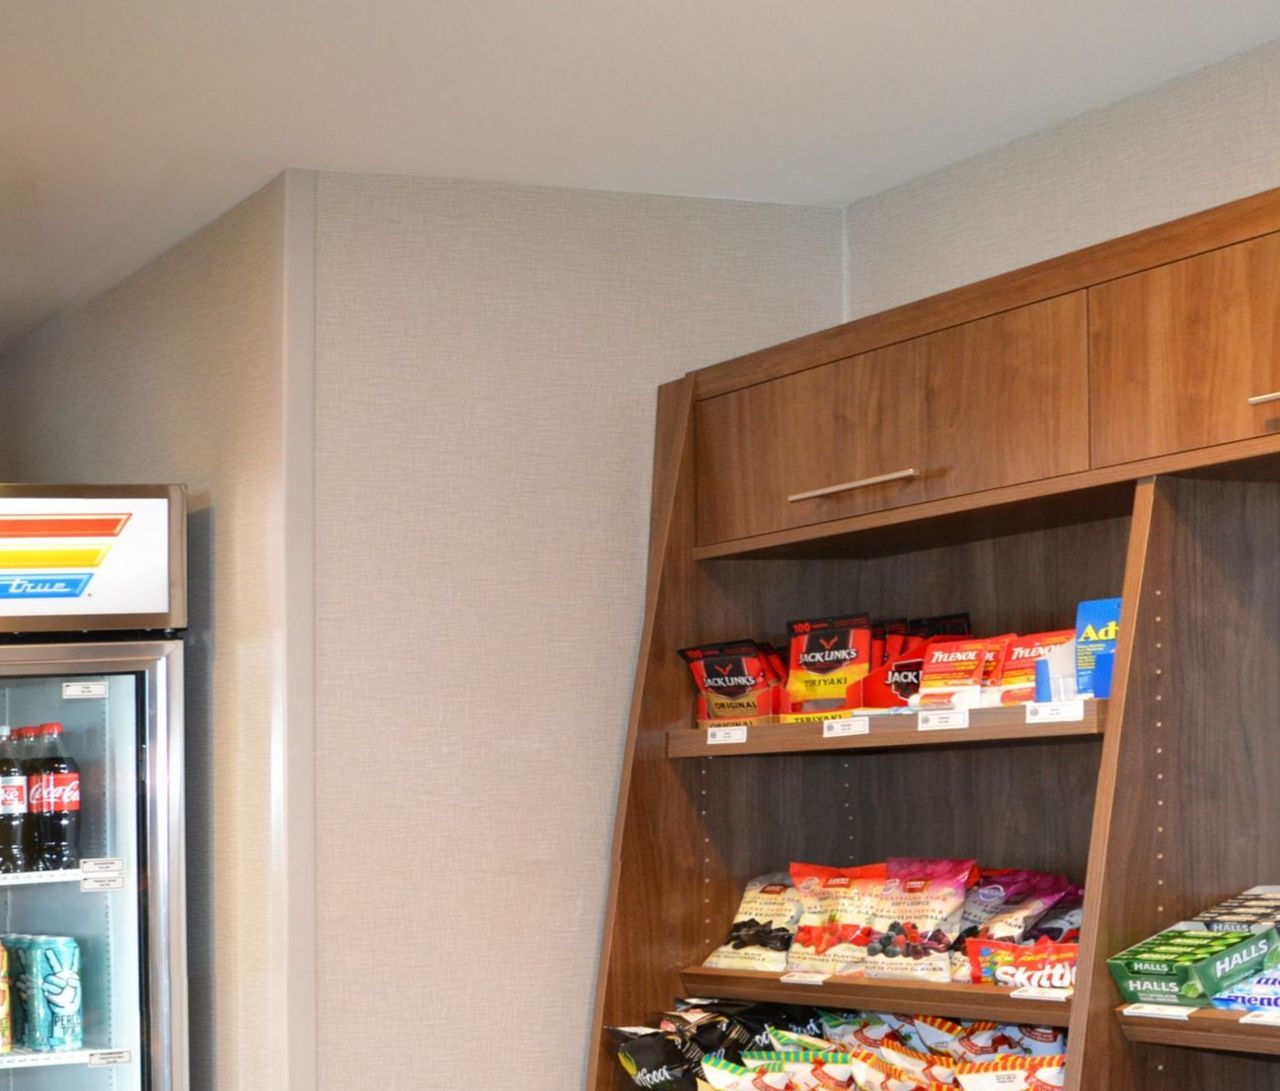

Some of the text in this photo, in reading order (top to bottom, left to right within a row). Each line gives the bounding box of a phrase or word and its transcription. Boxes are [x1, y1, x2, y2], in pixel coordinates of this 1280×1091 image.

[1215, 939, 1268, 977] HALLS
[1133, 963, 1168, 972] HALLS
[1128, 979, 1179, 992] HALLS
